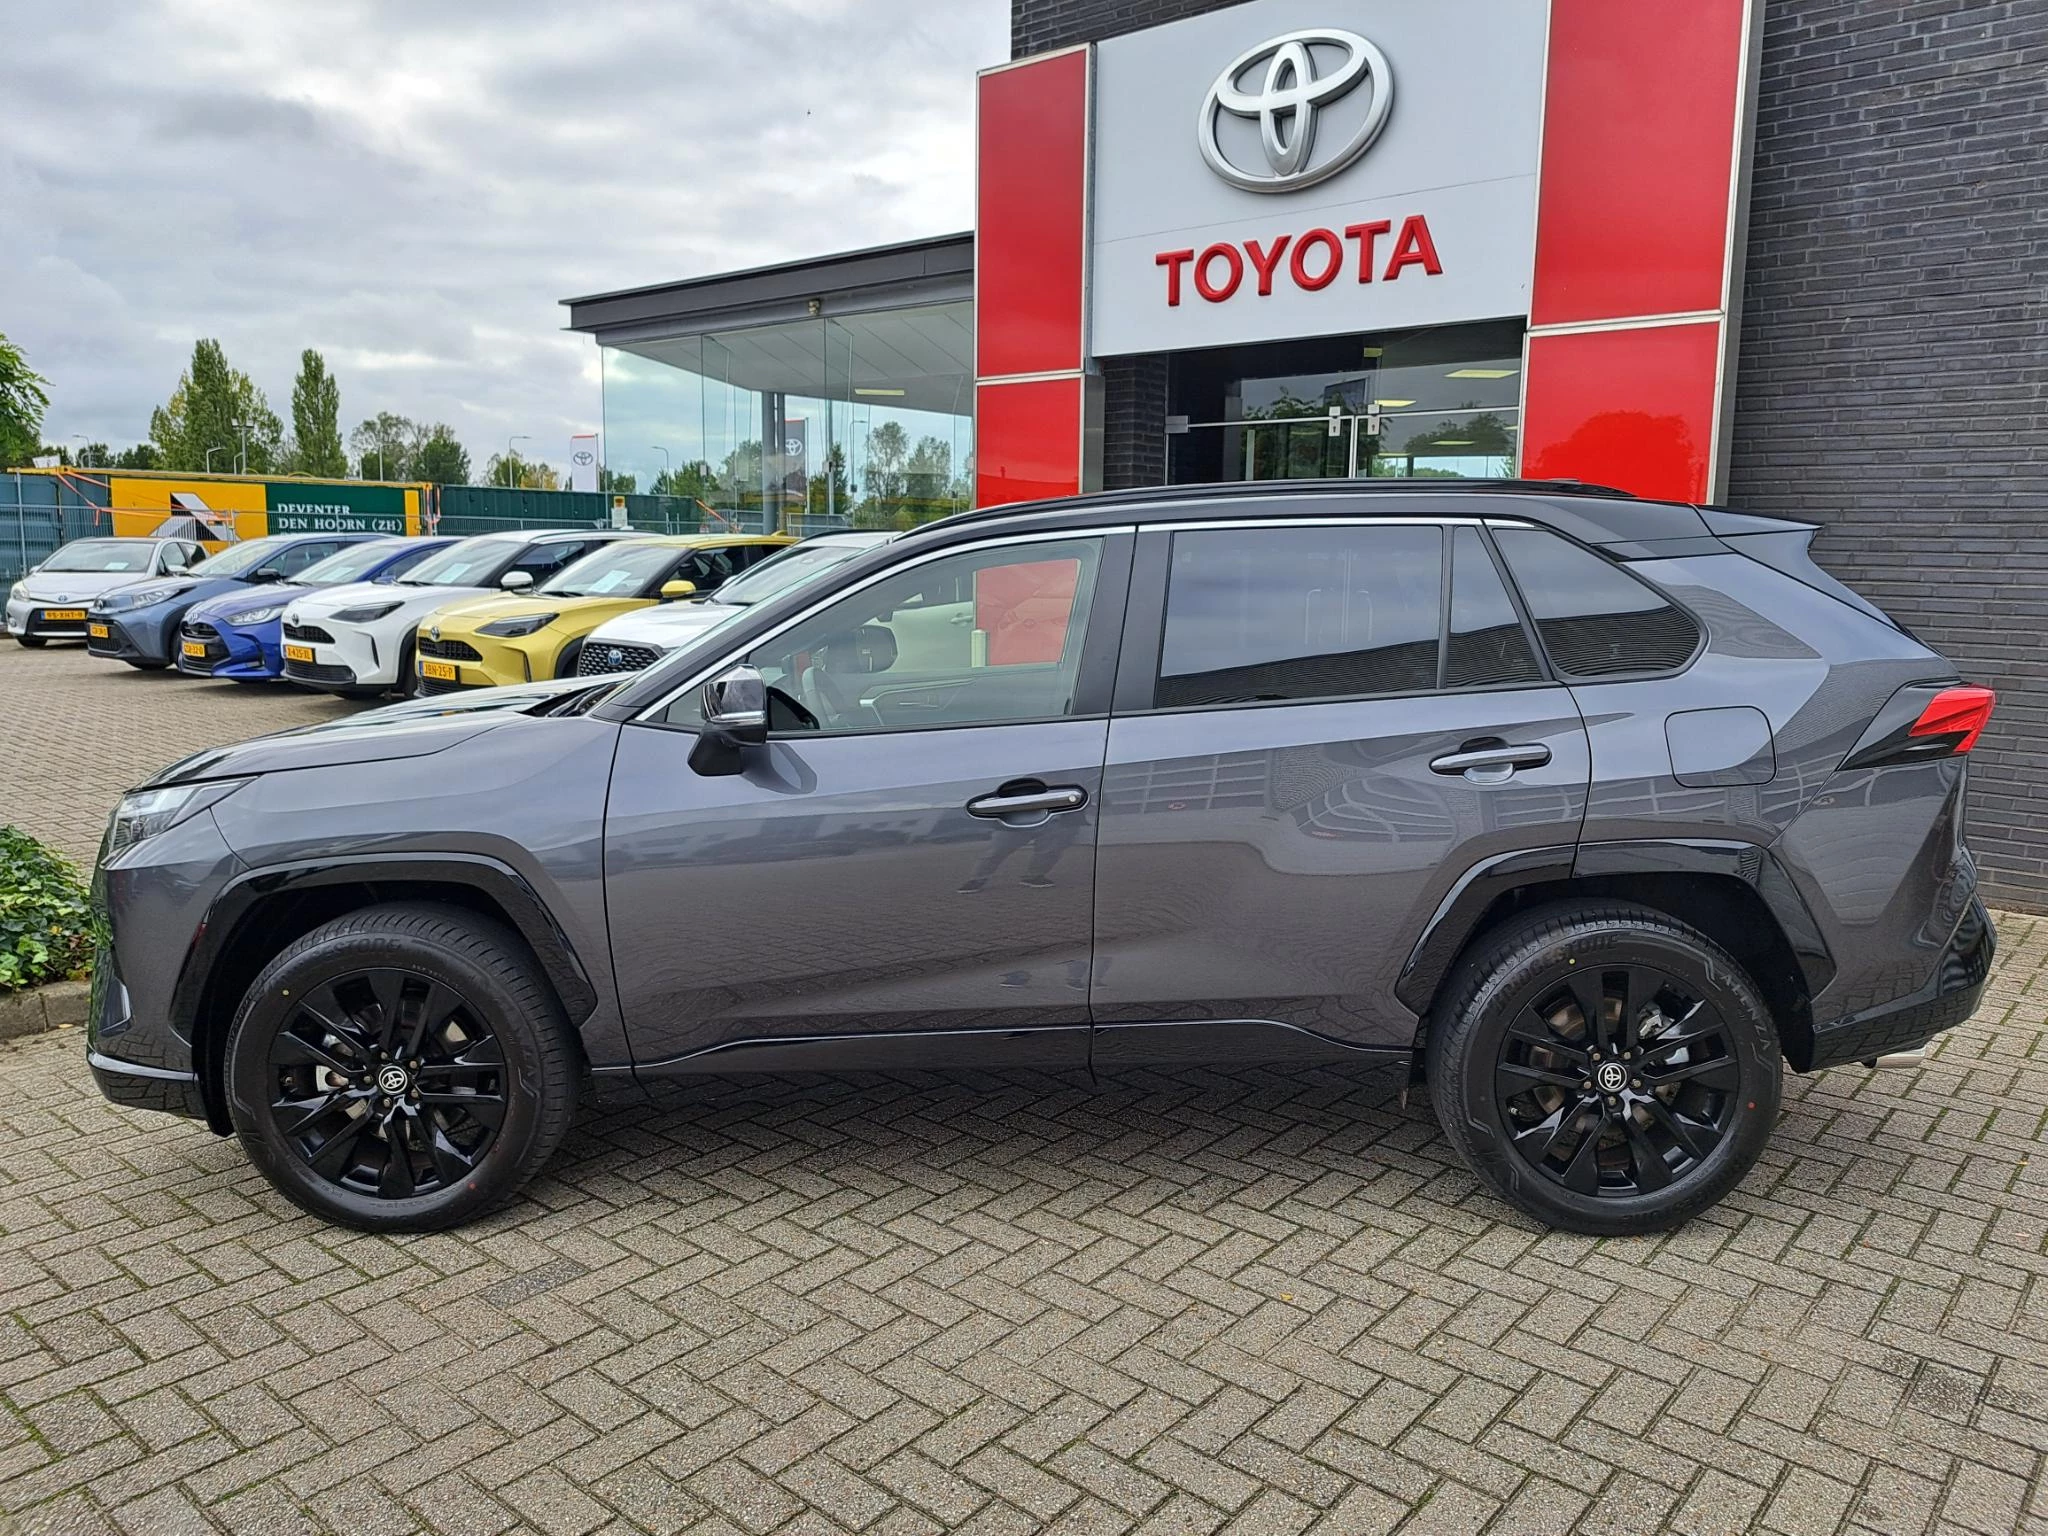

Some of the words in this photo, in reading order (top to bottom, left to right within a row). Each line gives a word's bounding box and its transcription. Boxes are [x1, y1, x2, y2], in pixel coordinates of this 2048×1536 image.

[1156, 215, 1443, 307] TOYOTA
[277, 502, 350, 515] DEVENTER
[278, 516, 308, 530] DEN
[314, 518, 366, 531] HOORN
[372, 518, 403, 532] (ZH)
[1719, 973, 1772, 1052] ALENZA
